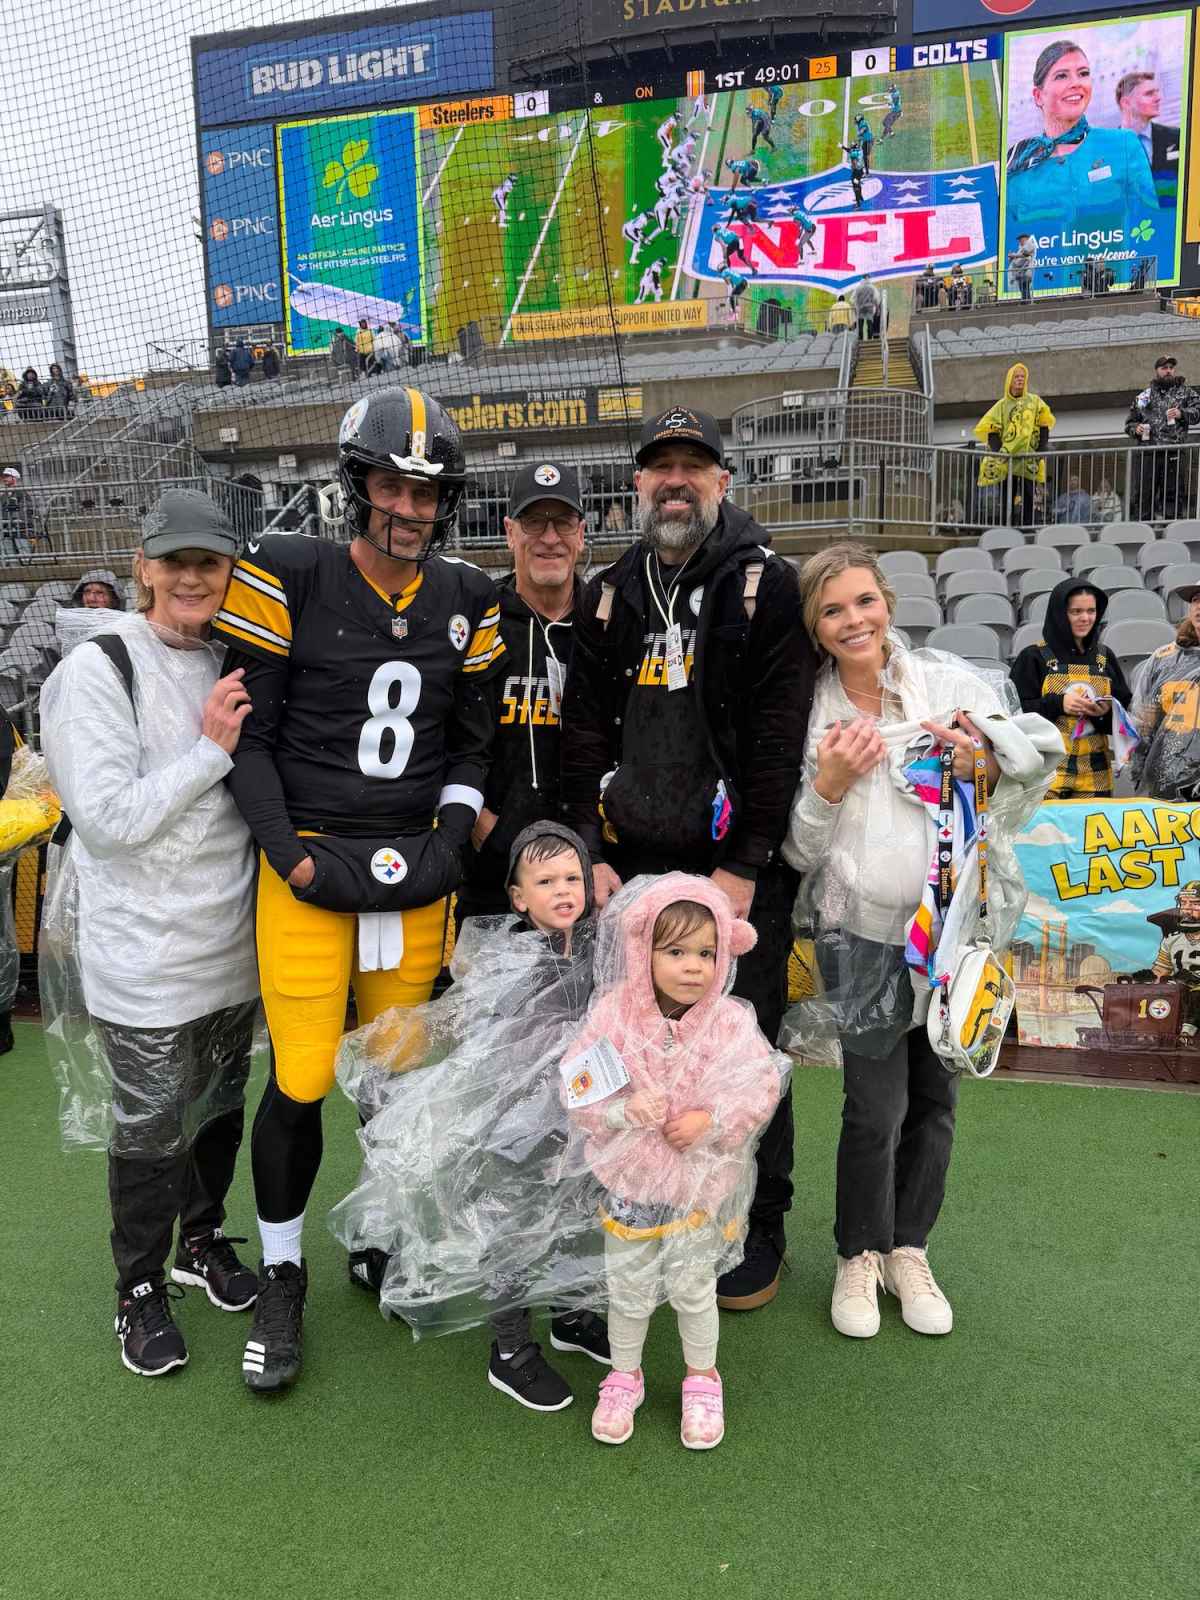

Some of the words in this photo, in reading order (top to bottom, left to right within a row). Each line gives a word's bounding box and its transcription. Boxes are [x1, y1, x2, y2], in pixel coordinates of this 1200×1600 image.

[864, 54, 876, 70] 0
[912, 38, 988, 67] COLTS
[251, 58, 323, 95] BUD
[327, 43, 430, 85] LIGHT
[714, 71, 745, 88] 1ST
[754, 63, 800, 84] 49:01
[815, 62, 831, 74] 25
[527, 97, 536, 111] 0
[593, 92, 603, 104] &
[635, 86, 653, 98] ON
[432, 102, 494, 125] Steelers
[228, 148, 271, 169] PNC
[231, 216, 274, 237] PNC
[311, 213, 338, 228] Aer
[340, 208, 393, 228] Lingus
[726, 210, 971, 271] NFL
[1062, 229, 1123, 249] Lingus
[1032, 256, 1057, 267] ou're
[1060, 254, 1085, 265] very
[235, 282, 278, 304] PNC
[652, 307, 682, 323] UNITED
[684, 305, 702, 320] WAY
[358, 660, 422, 779] 8
[1051, 847, 1185, 901] LAST
